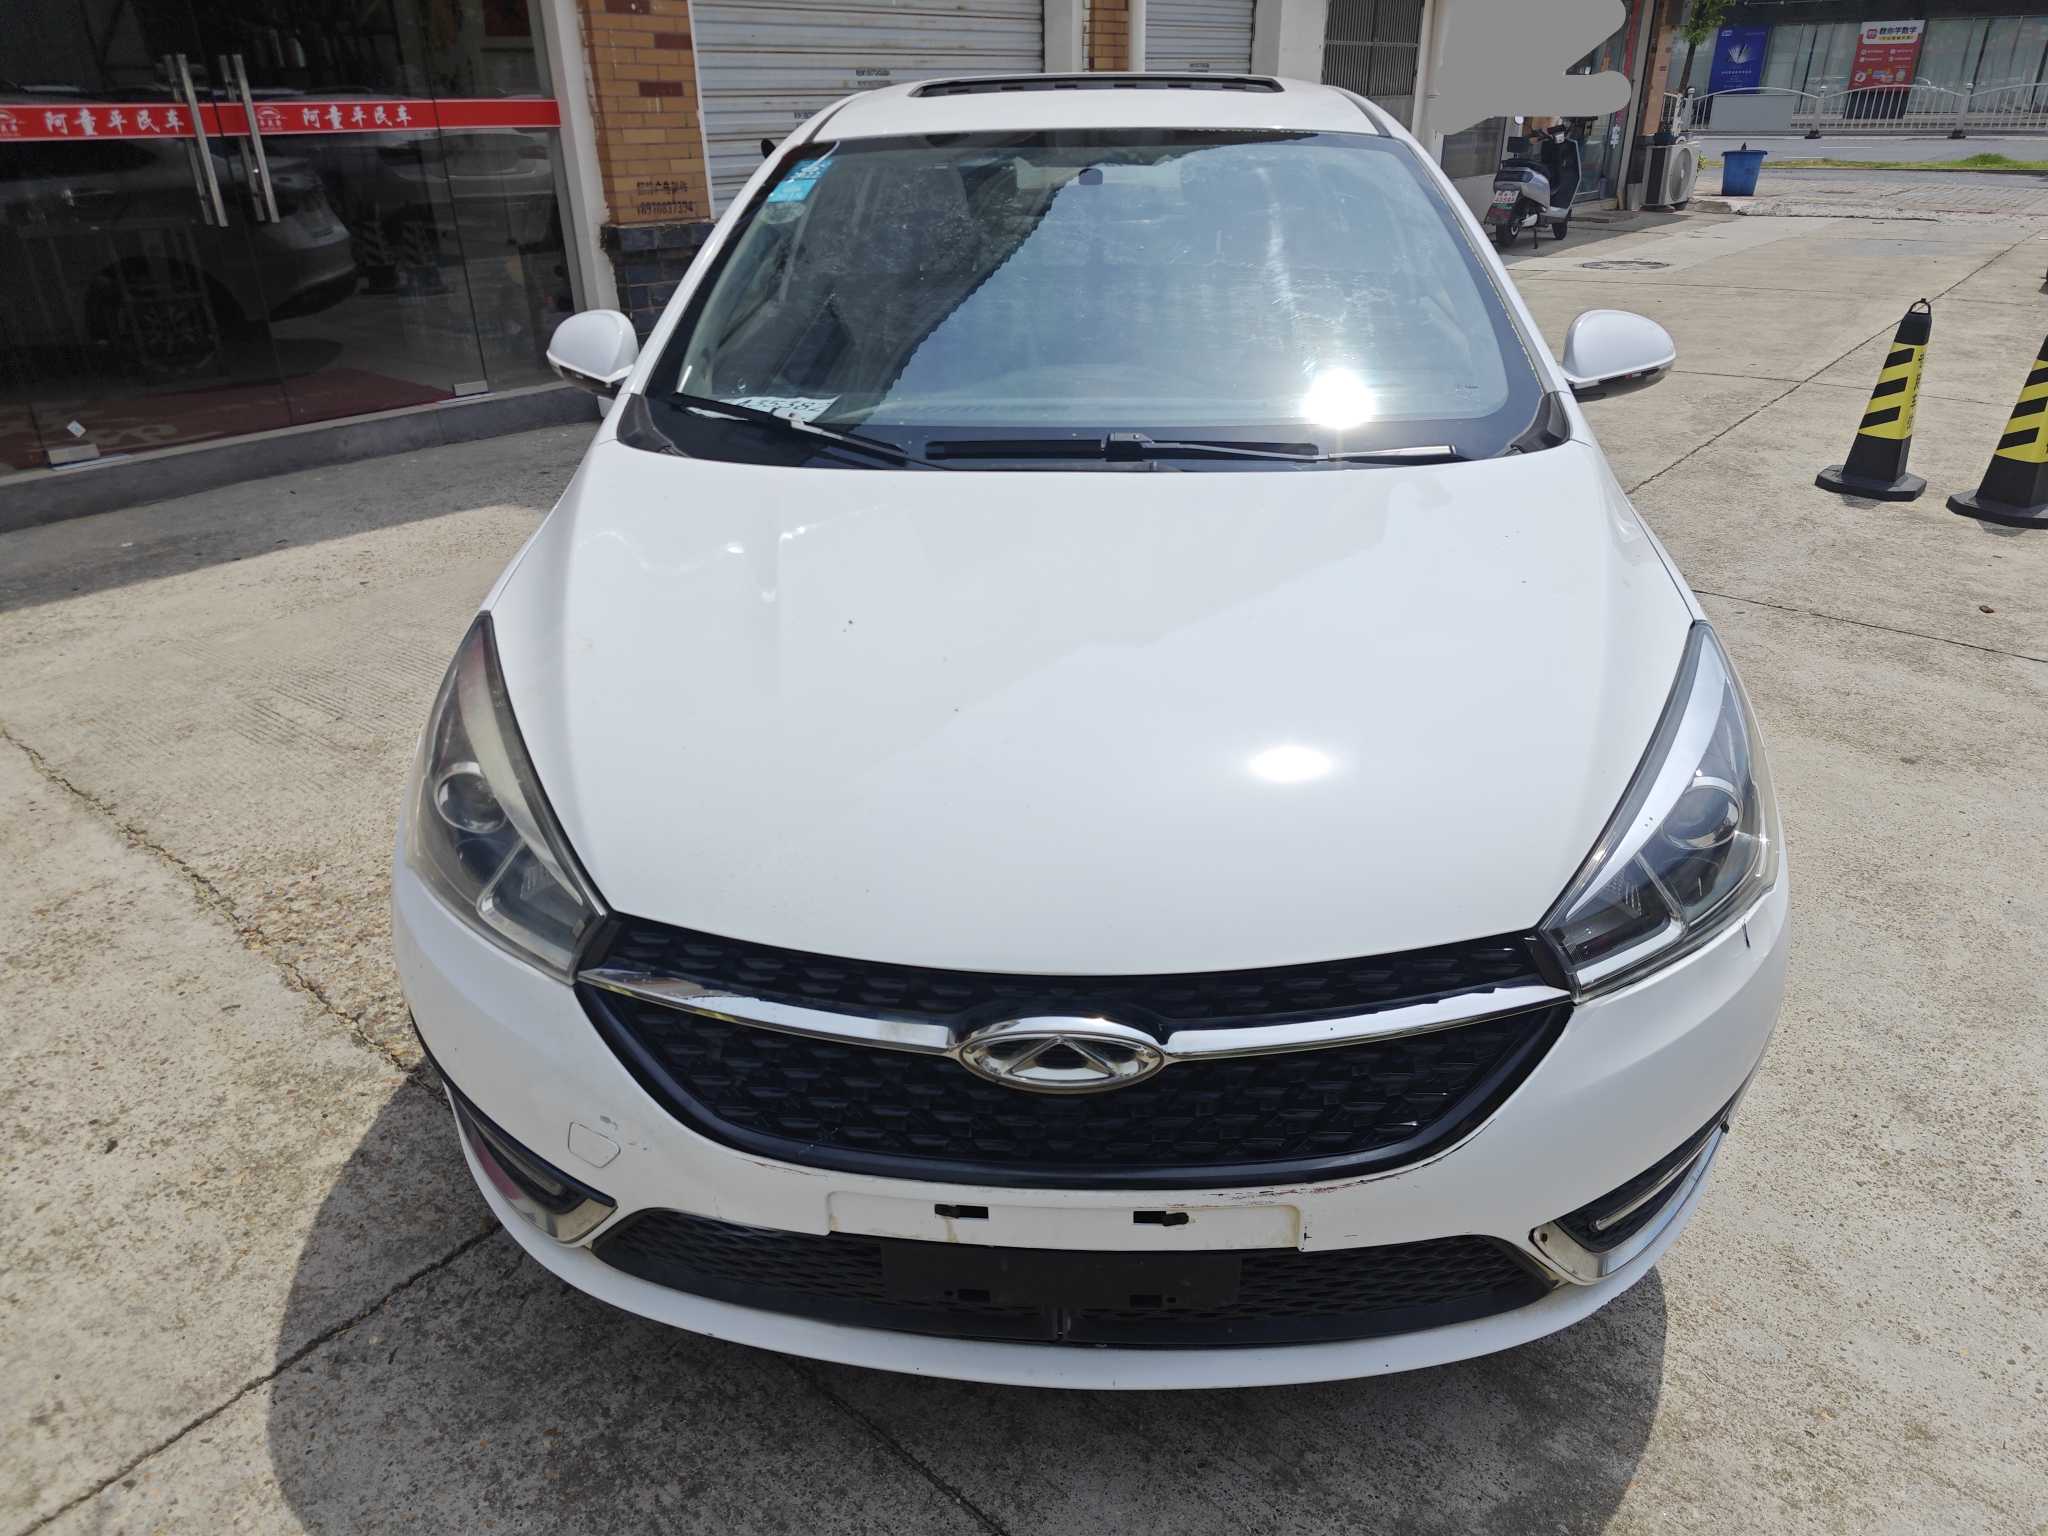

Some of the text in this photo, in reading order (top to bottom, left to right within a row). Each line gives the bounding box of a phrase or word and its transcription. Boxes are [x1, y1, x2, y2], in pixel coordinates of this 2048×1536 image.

[302, 104, 412, 129] 阿童平民车
